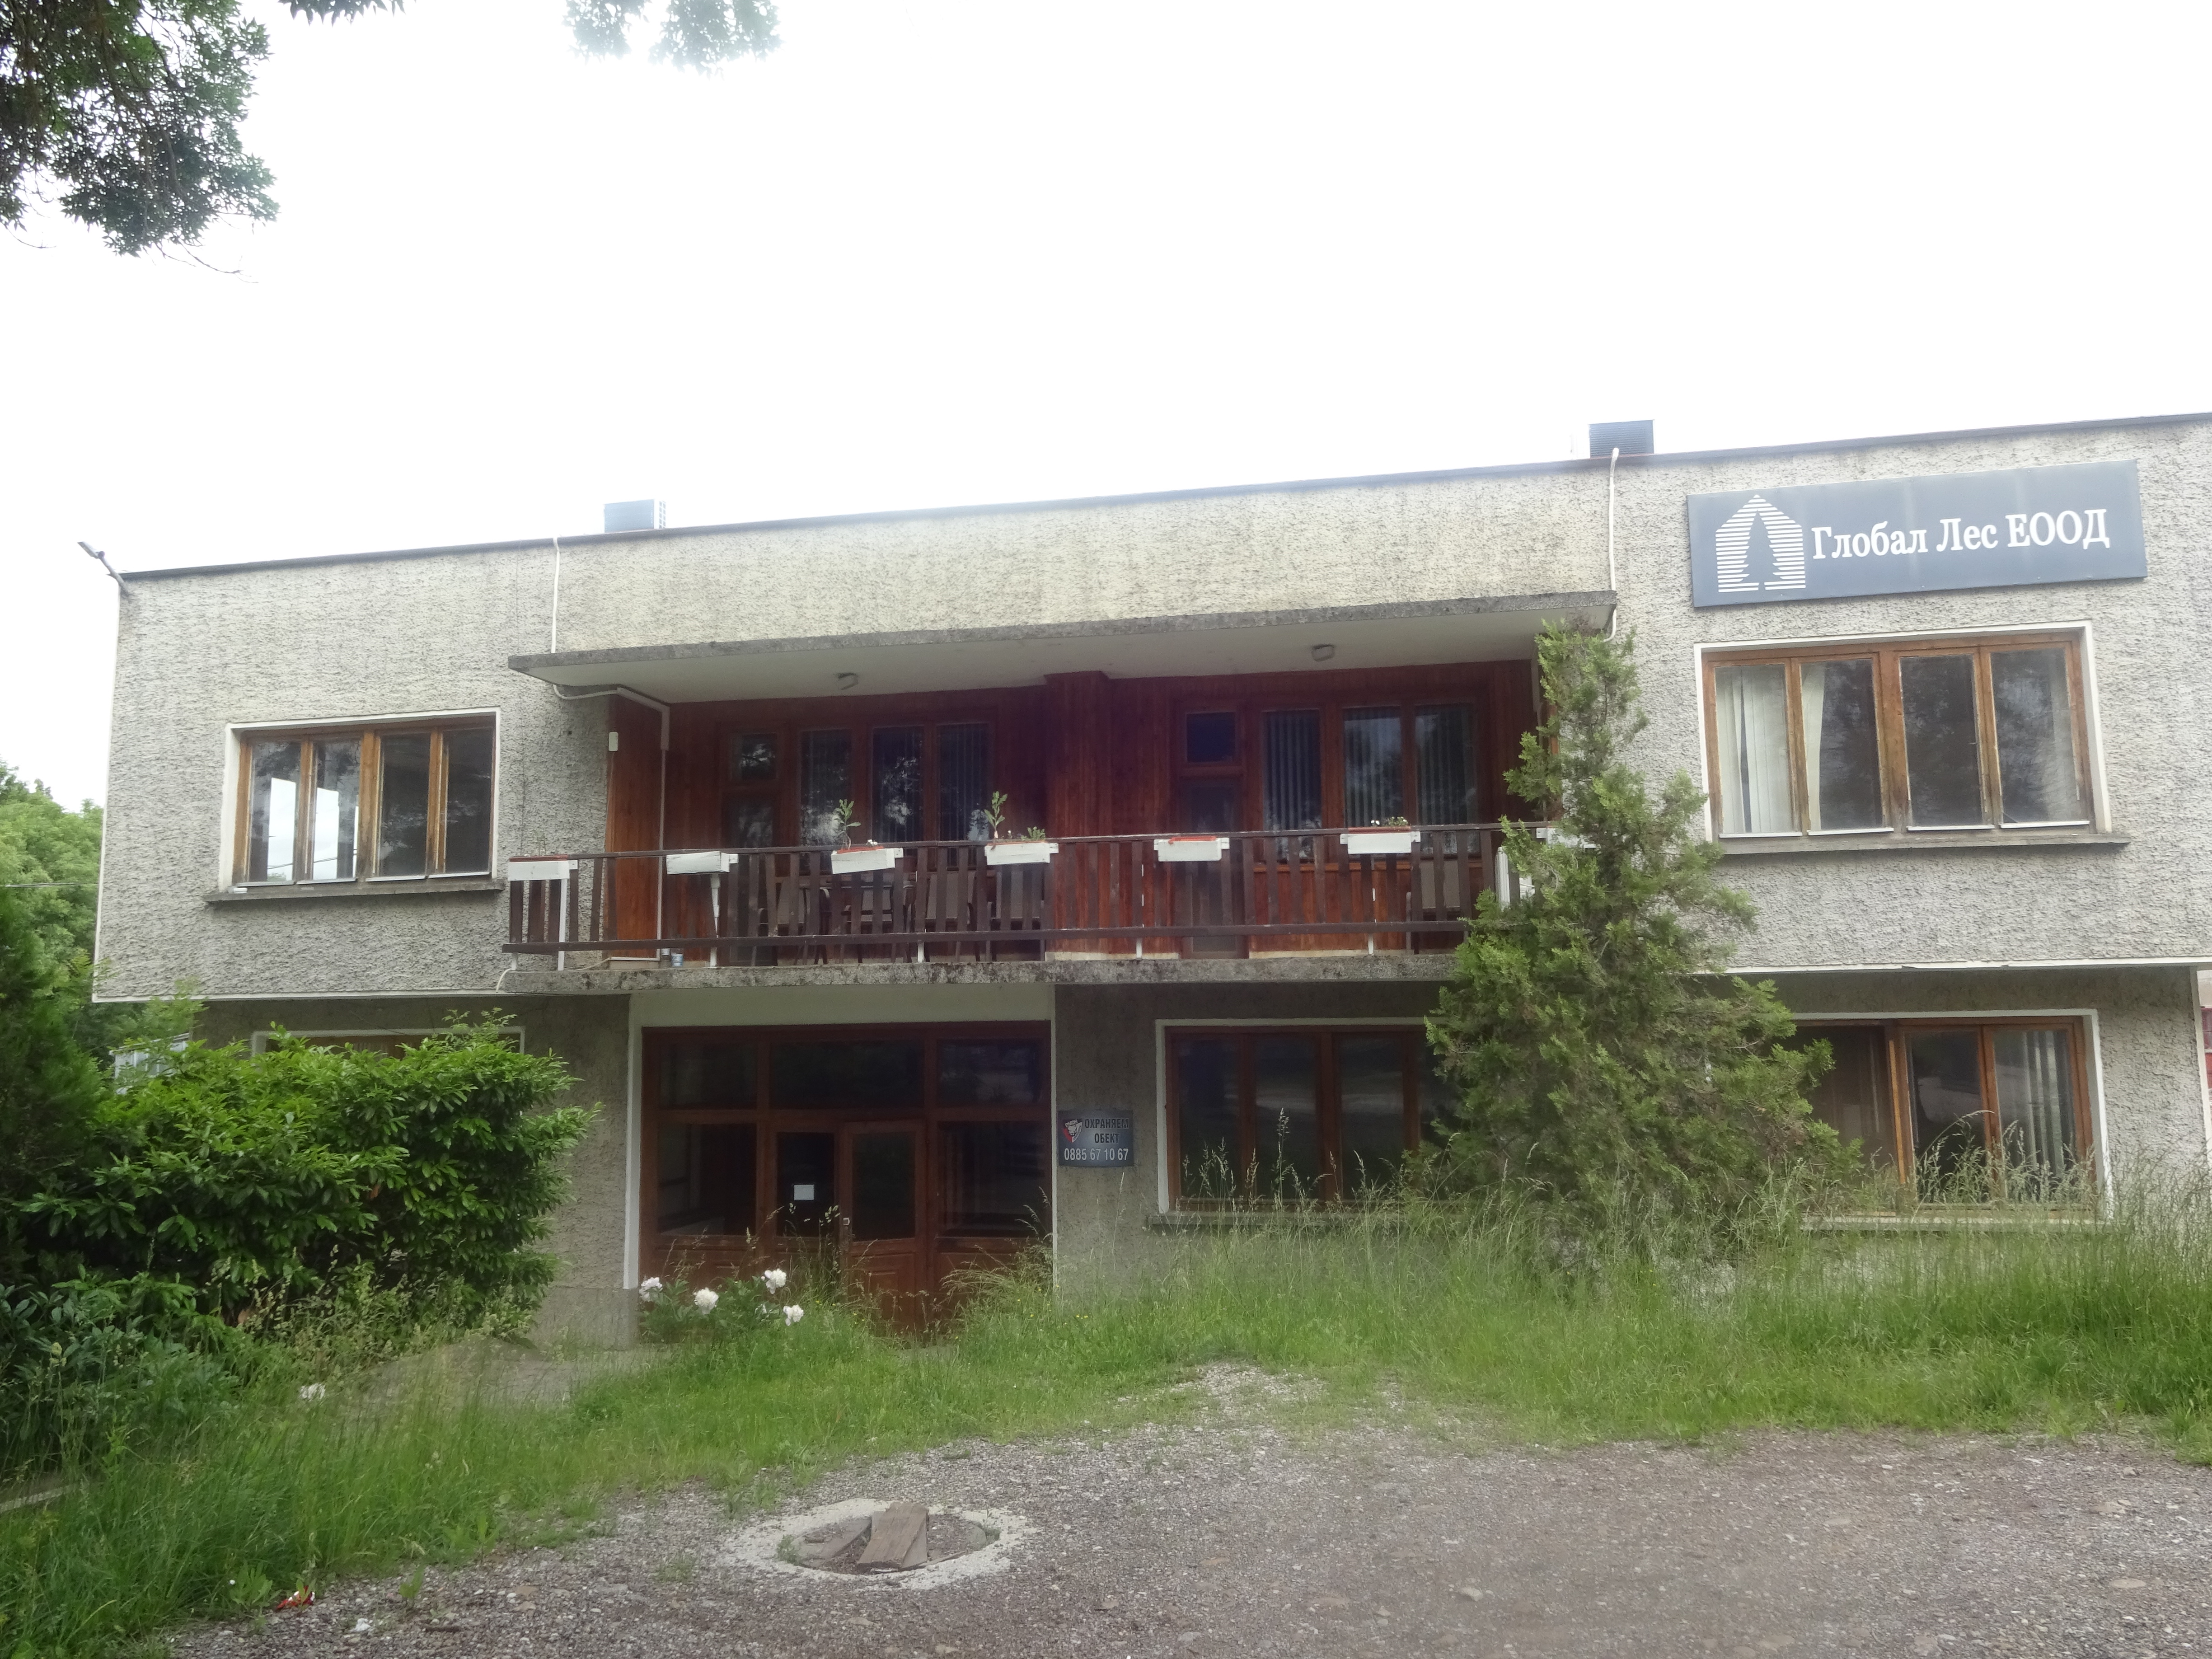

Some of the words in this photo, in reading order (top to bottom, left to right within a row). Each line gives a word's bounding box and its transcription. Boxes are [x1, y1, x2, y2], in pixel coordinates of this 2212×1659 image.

[1811, 521, 1928, 560] Глобал
[1936, 518, 1998, 552] Лес
[2005, 509, 2110, 550] ЕООД
[1085, 1118, 1129, 1129] ОХРАНЯЕМ
[1094, 1133, 1119, 1143] ОБЕКТ
[1064, 1148, 1087, 1160] 0885
[1090, 1148, 1101, 1160] 67
[1104, 1148, 1115, 1160] 10
[1117, 1148, 1129, 1160] 67
